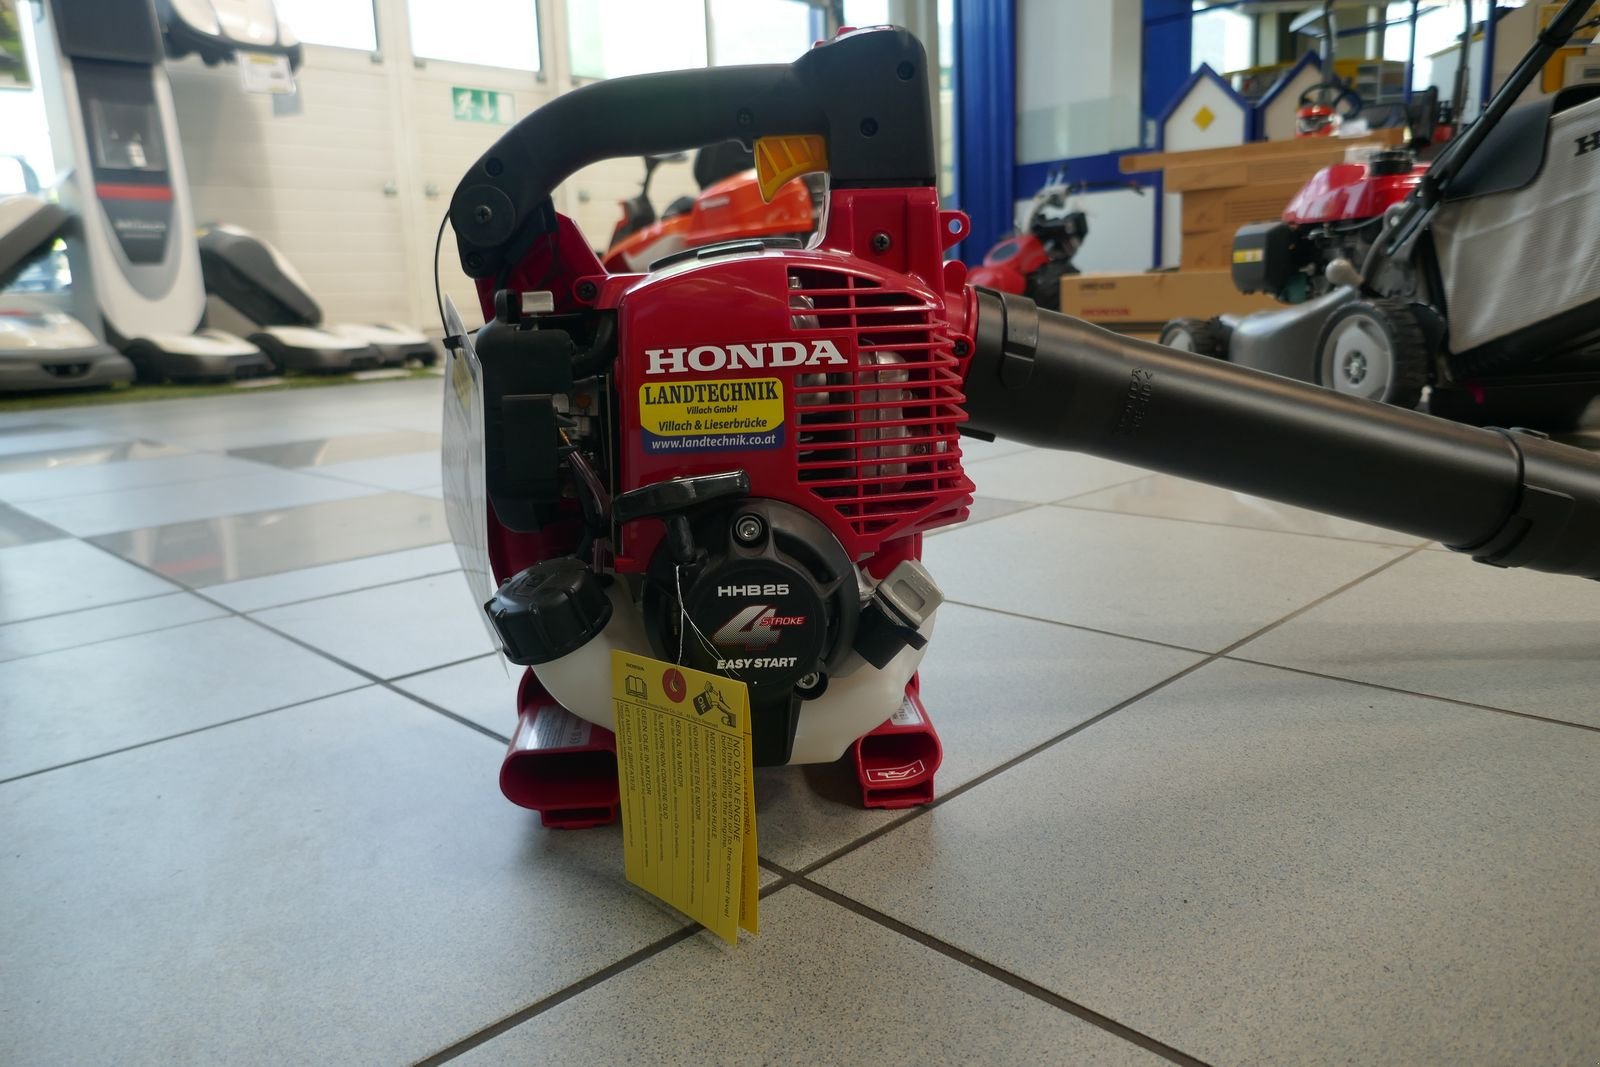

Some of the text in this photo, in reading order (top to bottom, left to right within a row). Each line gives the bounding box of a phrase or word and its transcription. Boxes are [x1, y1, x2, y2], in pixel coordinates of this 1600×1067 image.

[644, 340, 848, 374] HONDA
[644, 381, 778, 405] LANDTECHNIK
[687, 404, 738, 415] Villach GmbH
[658, 418, 767, 432] Villach & Lieserbrücke
[652, 434, 776, 449] www.landtechnik.co.at
[712, 605, 806, 650] 4 STROKE
[716, 657, 798, 670] EASY START
[697, 696, 706, 713] OIL
[640, 708, 648, 732] GEEN
[644, 753, 649, 763] IN
[693, 724, 698, 737] NO
[676, 749, 682, 759] IM
[732, 738, 740, 758] NO
[694, 775, 700, 786] EN
[734, 782, 740, 795] IN
[733, 796, 741, 843] ENGINE
[727, 835, 732, 845] to
